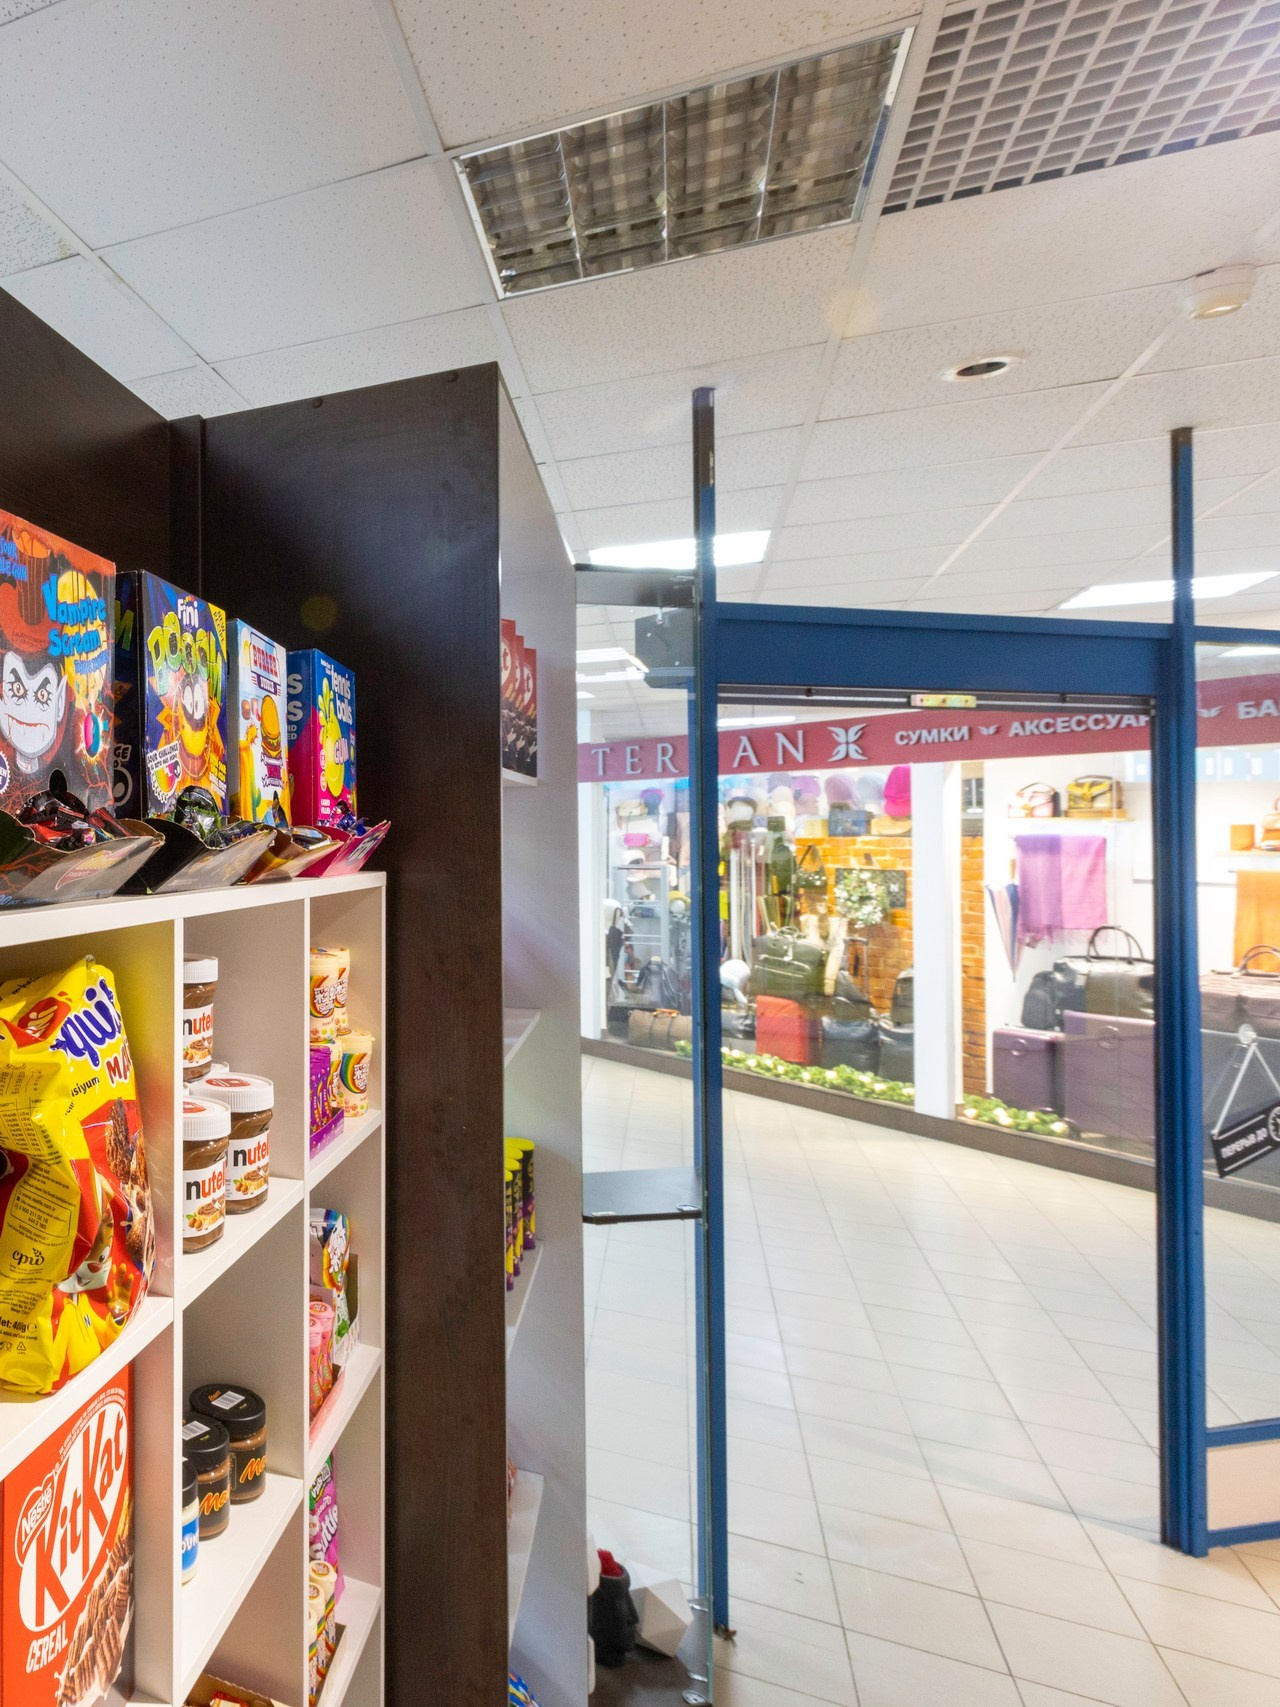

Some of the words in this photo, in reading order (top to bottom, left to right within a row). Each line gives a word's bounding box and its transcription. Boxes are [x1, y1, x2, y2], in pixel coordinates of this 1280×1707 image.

[41, 573, 107, 627] Vampire
[177, 598, 199, 629] Fini
[48, 627, 103, 658] Scream
[592, 730, 804, 777] TERAN
[894, 725, 970, 745] СУМКИ
[21, 1482, 54, 1537] Nestlé
[35, 1408, 124, 1628] KitKat
[26, 1628, 69, 1674] CEREAL
